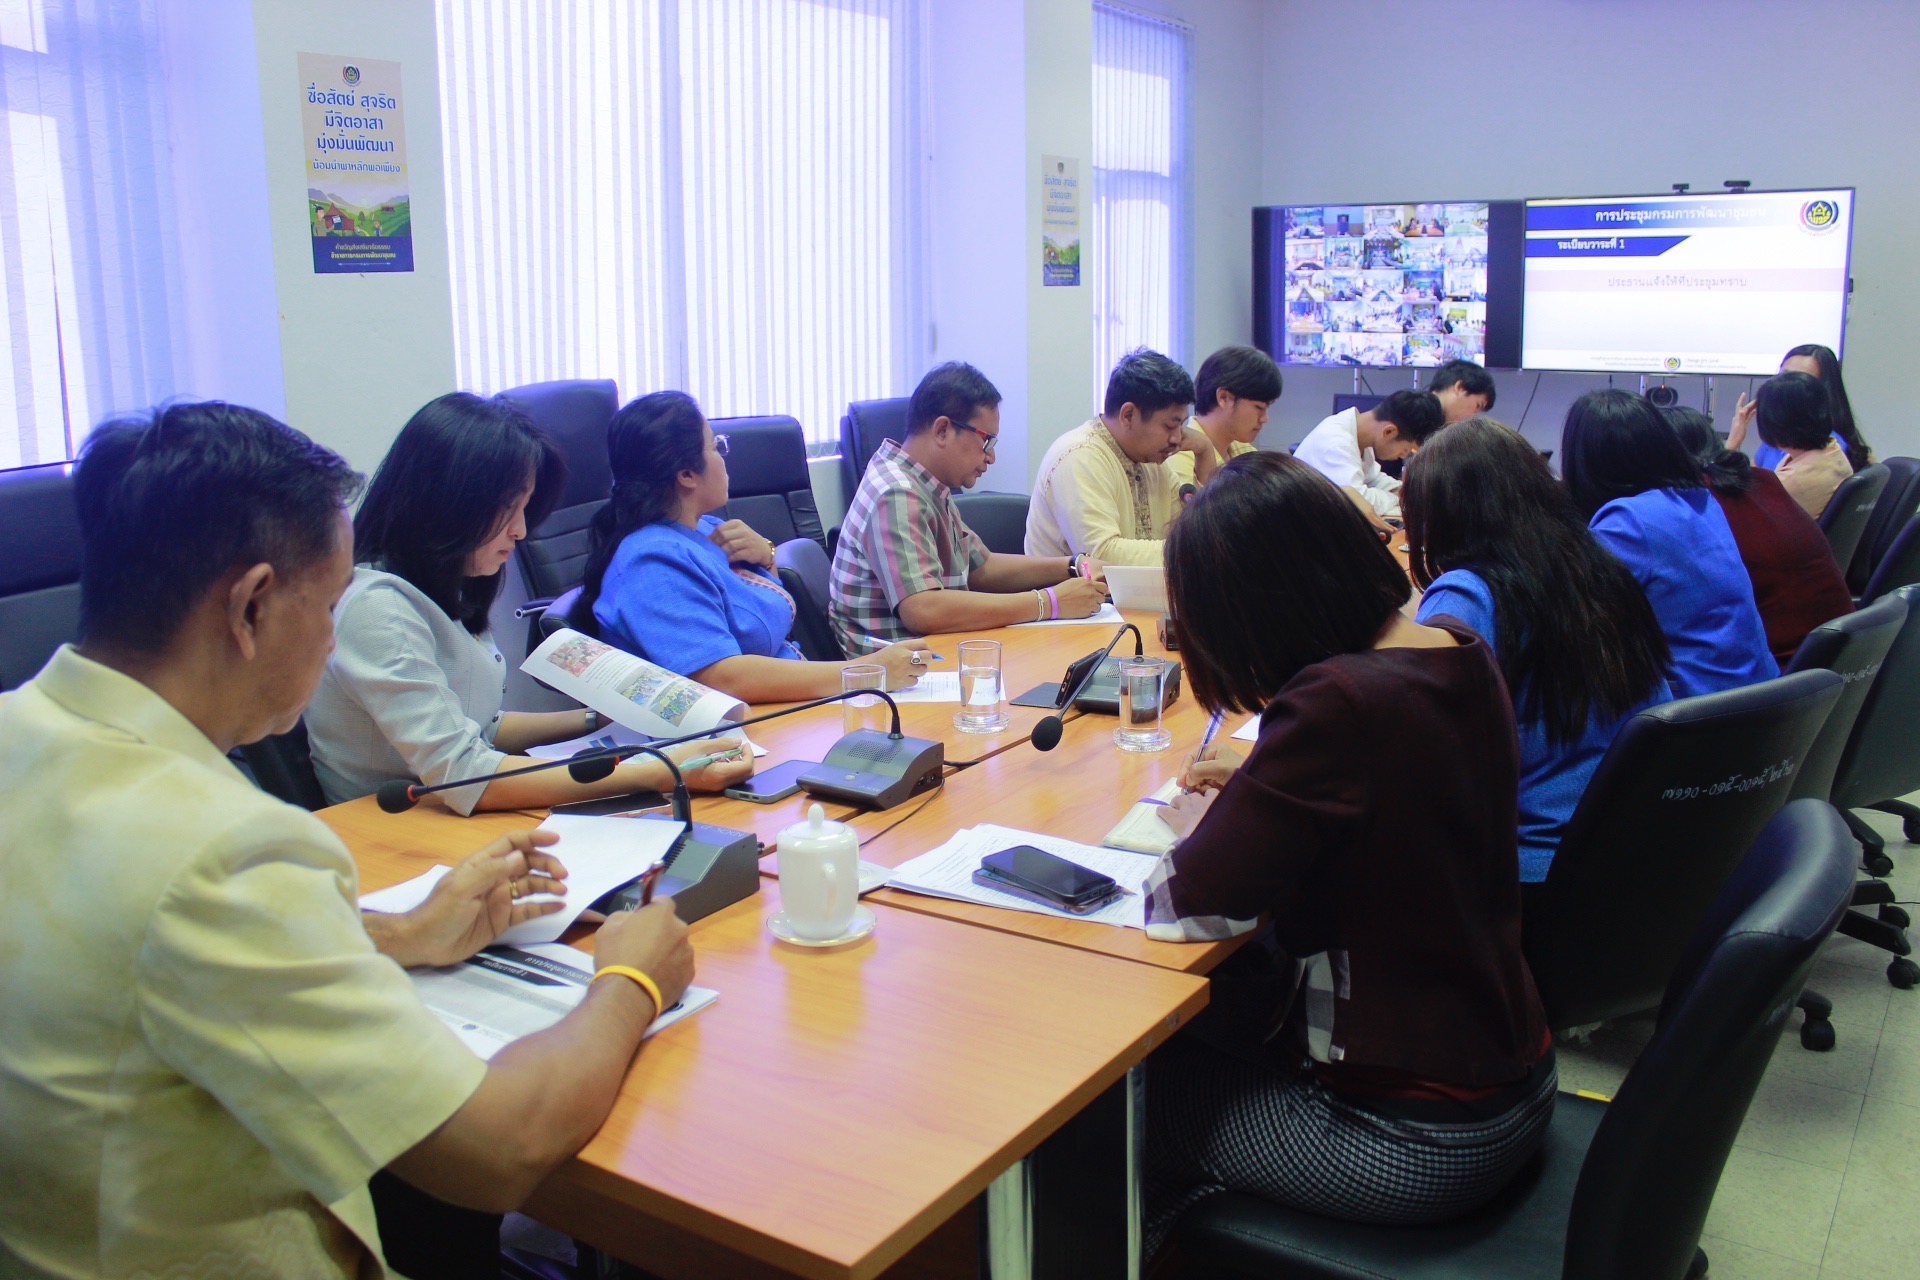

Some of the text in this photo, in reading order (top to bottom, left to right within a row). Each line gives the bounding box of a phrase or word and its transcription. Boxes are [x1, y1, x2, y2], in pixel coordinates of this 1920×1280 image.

[307, 82, 396, 113] ซื่อสัตย์ สุจริต
[325, 110, 384, 130] มีจิตอาสา
[317, 129, 394, 154] มุ่งมั่นพัฒนา
[313, 158, 401, 173] น้อมนำพาหลักพอเพียง
[1557, 236, 1626, 250] ระเบียบวาระที่ 1
[1607, 274, 1748, 291] ประธานแจ้งให้ที่ประชุมทราบ
